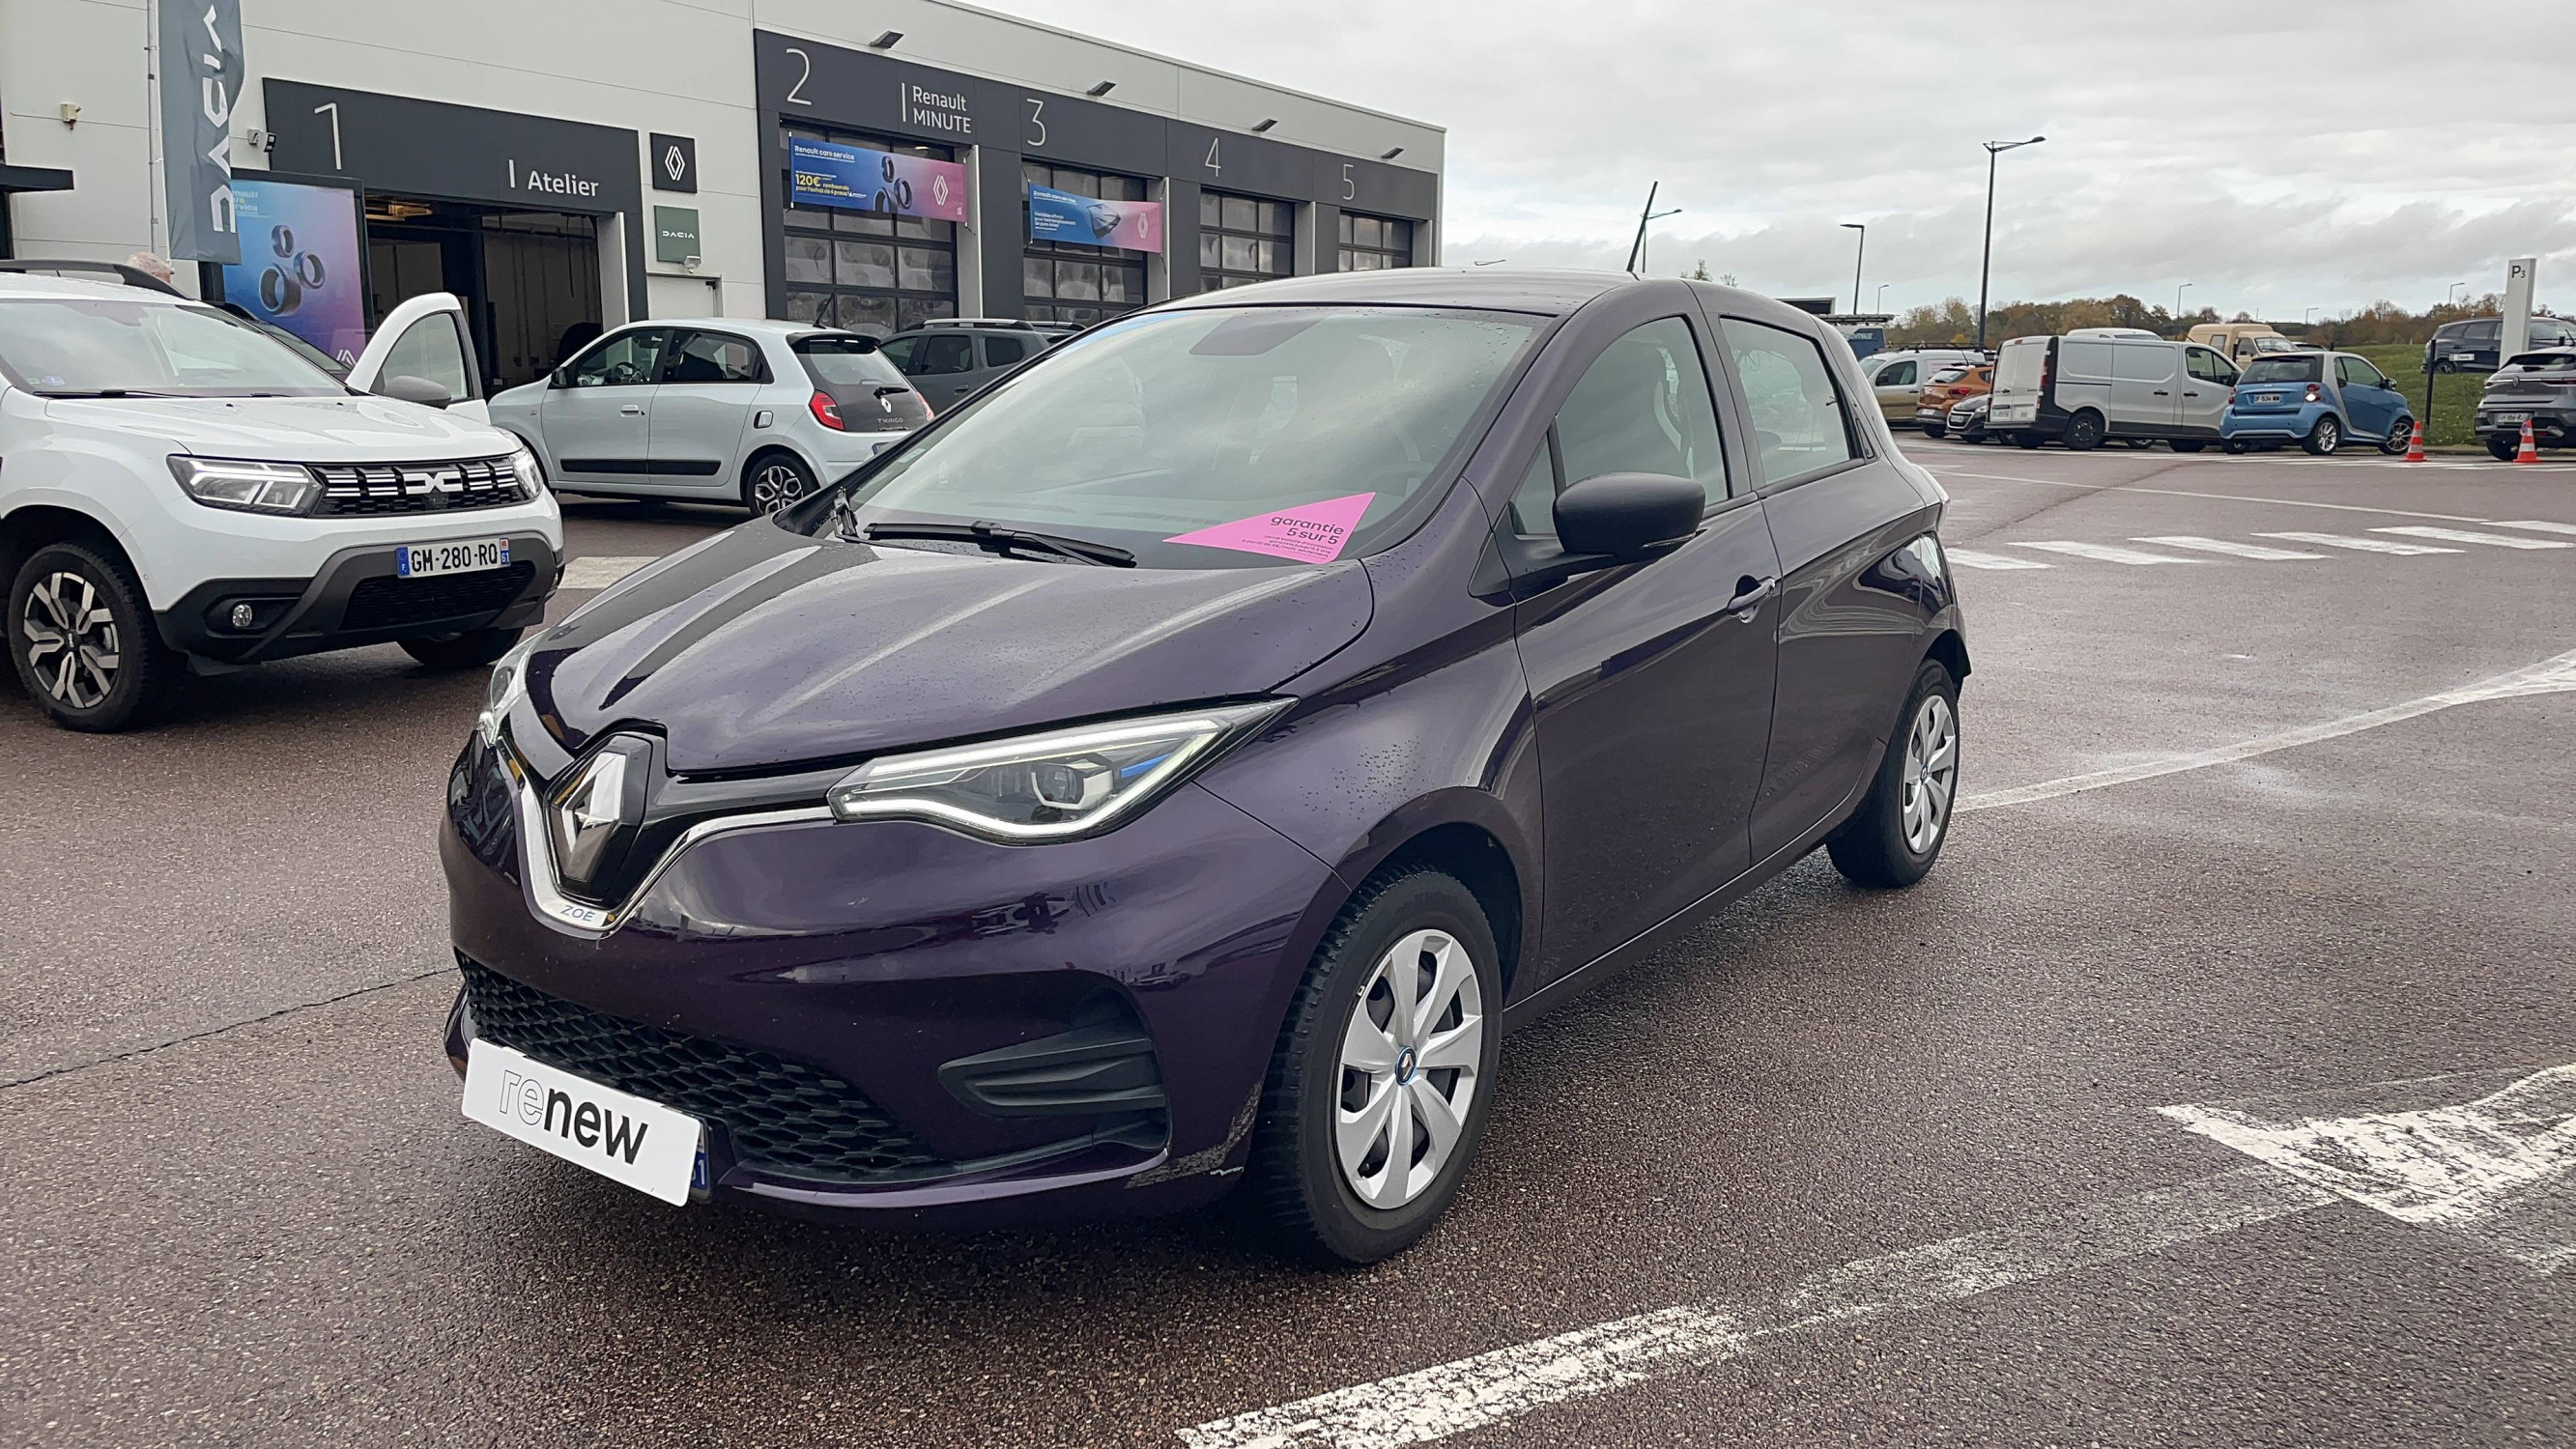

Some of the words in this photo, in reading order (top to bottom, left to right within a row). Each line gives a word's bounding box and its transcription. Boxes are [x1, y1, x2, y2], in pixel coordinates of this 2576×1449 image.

[786, 47, 813, 106] 2
[912, 85, 967, 112] Renault
[913, 107, 972, 134] MINUTE
[1026, 98, 1046, 147] 3
[314, 102, 342, 170] 1
[794, 145, 819, 156] Renault
[1205, 137, 1221, 178] 4
[528, 170, 599, 197] Atelier
[795, 174, 821, 187] 120€
[1342, 163, 1355, 201] 5
[662, 230, 695, 240] DACIA
[1271, 516, 1344, 535] garantie
[1287, 527, 1299, 537] 5
[1299, 530, 1328, 542] sur
[1327, 535, 1340, 545] 5
[411, 543, 499, 573] GM-280-RQ
[501, 552, 510, 563] 61
[560, 904, 596, 923] ZOE
[499, 1069, 649, 1166] renew
